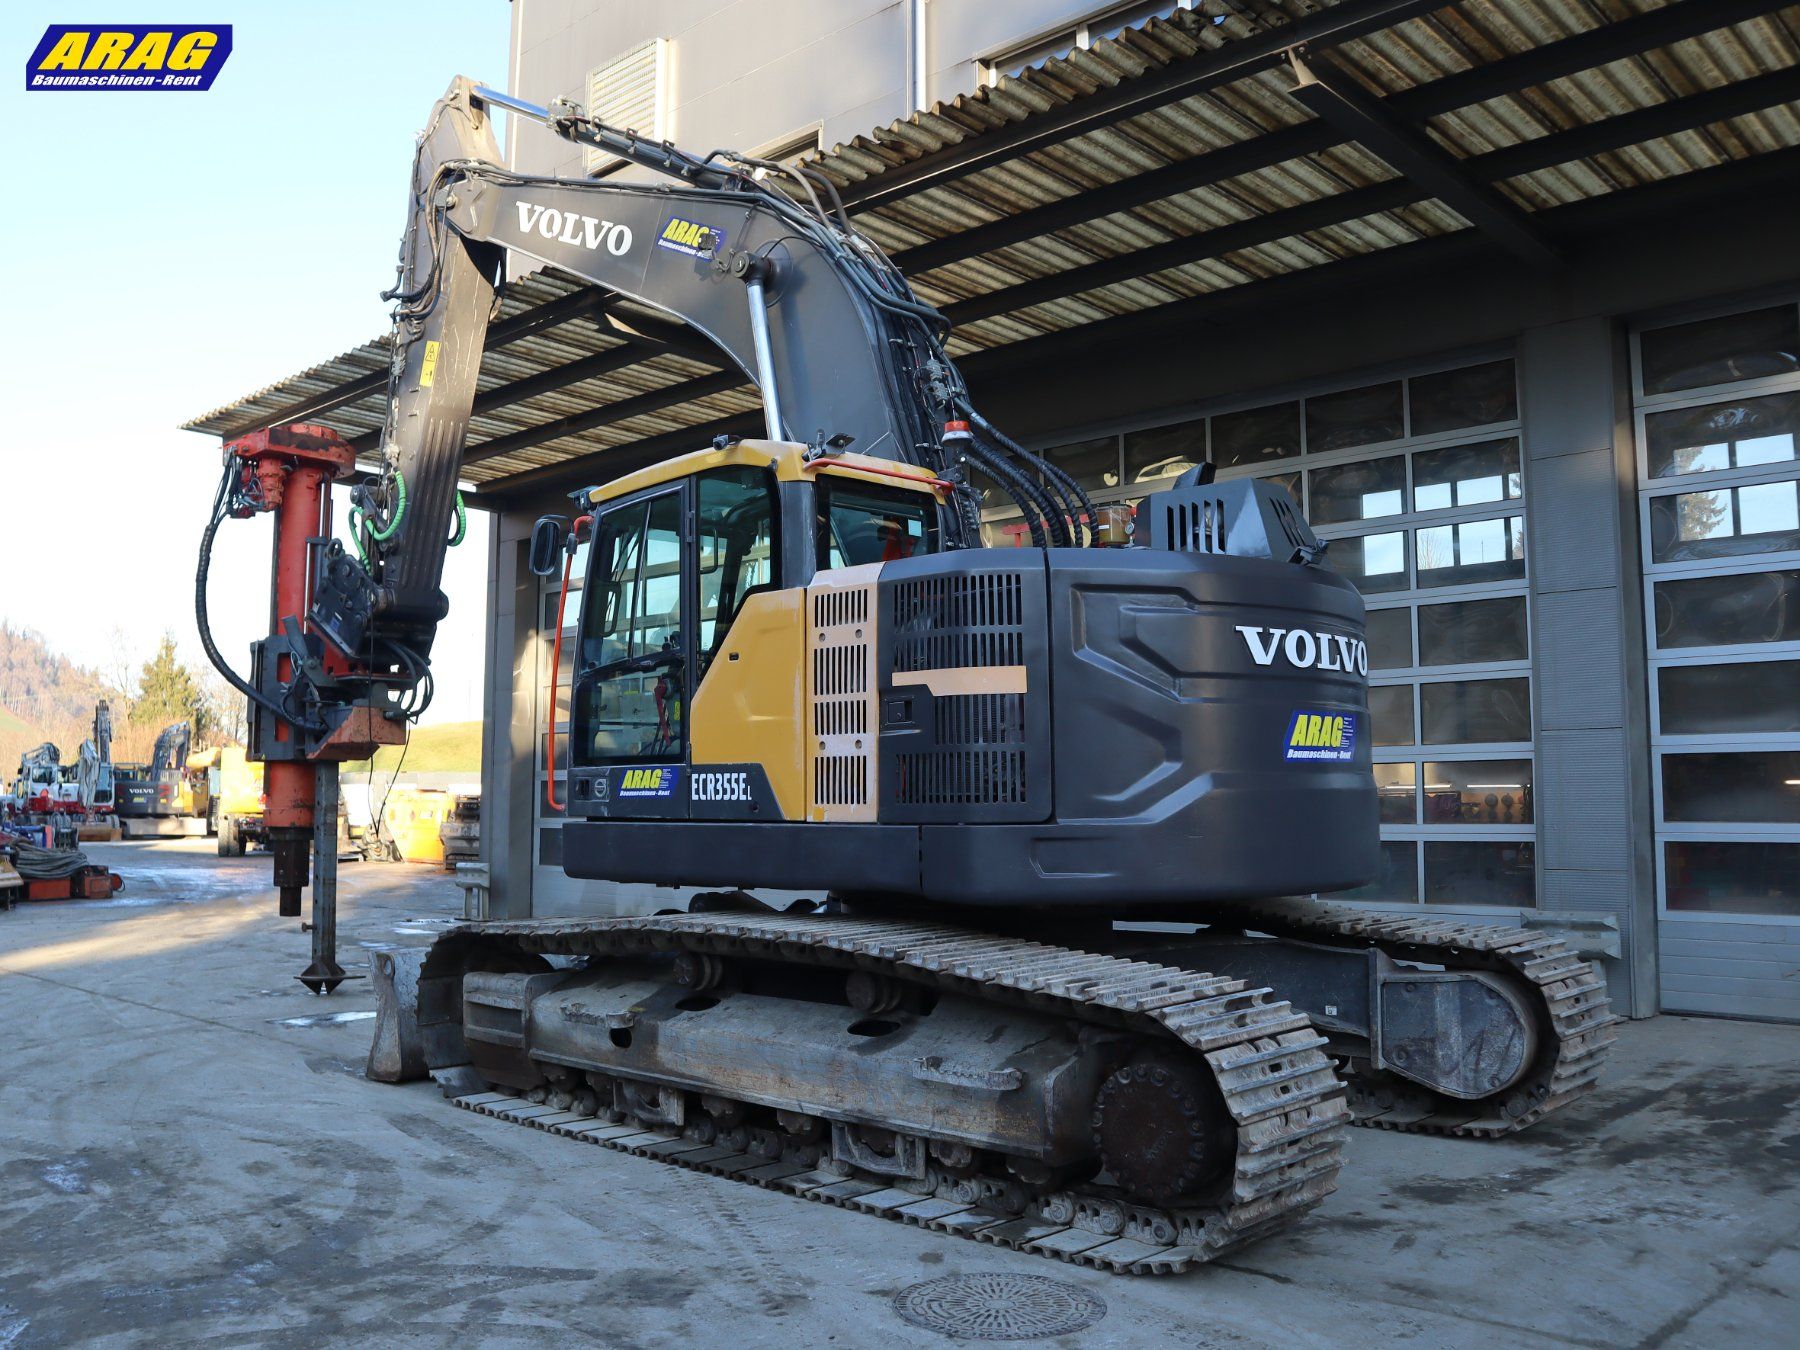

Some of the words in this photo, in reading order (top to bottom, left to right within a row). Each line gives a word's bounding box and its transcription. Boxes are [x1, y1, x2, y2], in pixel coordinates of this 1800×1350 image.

[515, 200, 633, 257] VOLVO
[1235, 625, 1368, 677] VOLVO
[1289, 714, 1343, 748] ARAG
[621, 768, 663, 789] ARAG
